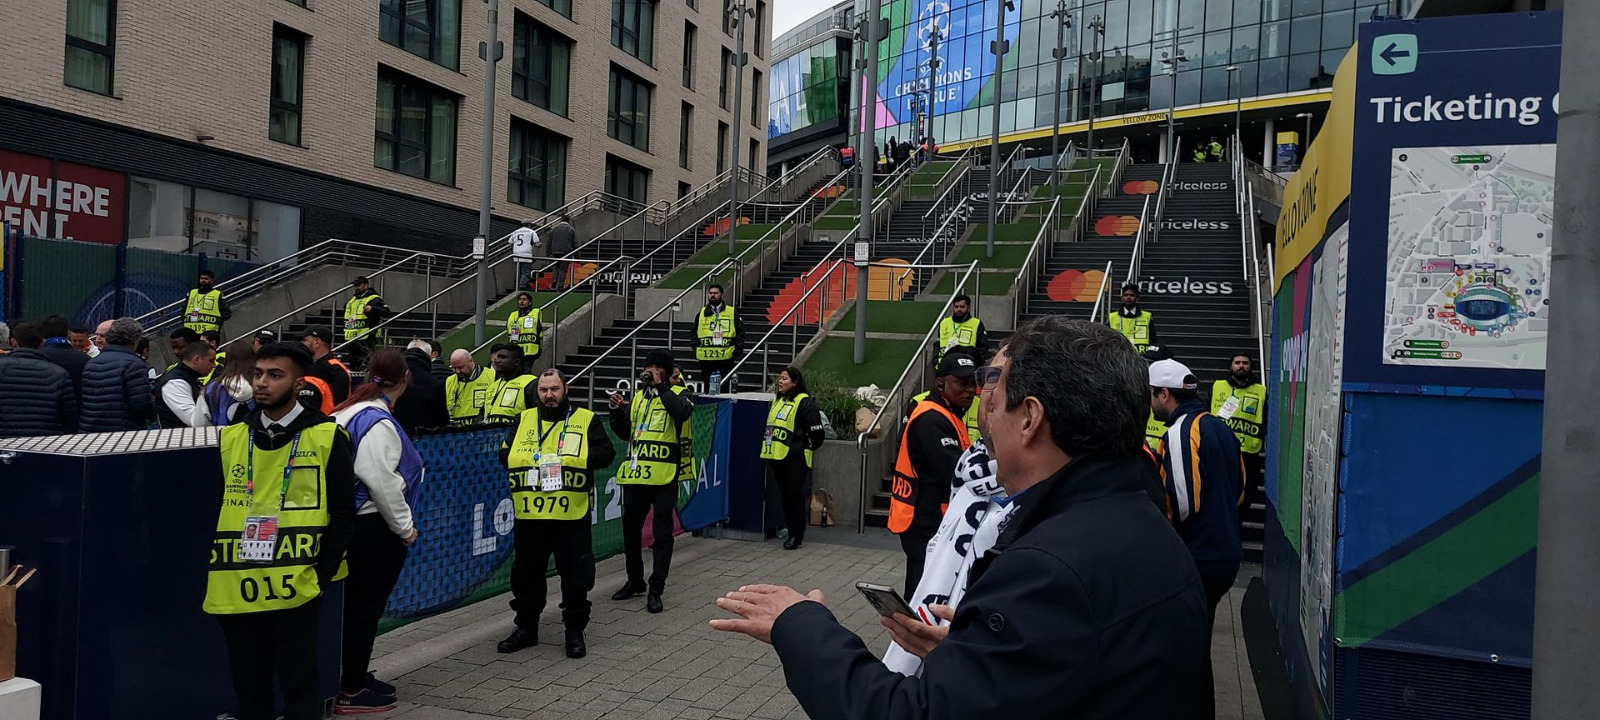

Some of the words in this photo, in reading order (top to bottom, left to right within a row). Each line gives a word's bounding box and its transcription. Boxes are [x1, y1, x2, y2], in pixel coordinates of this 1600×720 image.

[907, 88, 957, 111] LAGUE
[1370, 92, 1543, 126] Ticketing
[1122, 114, 1148, 124] YELLOW
[1149, 218, 1230, 231] priceless
[517, 233, 525, 247] 5
[703, 350, 726, 358] 1217
[508, 470, 587, 489] STRD
[523, 496, 569, 513] 1979
[209, 533, 322, 564] STEARD
[241, 574, 297, 603] 015
